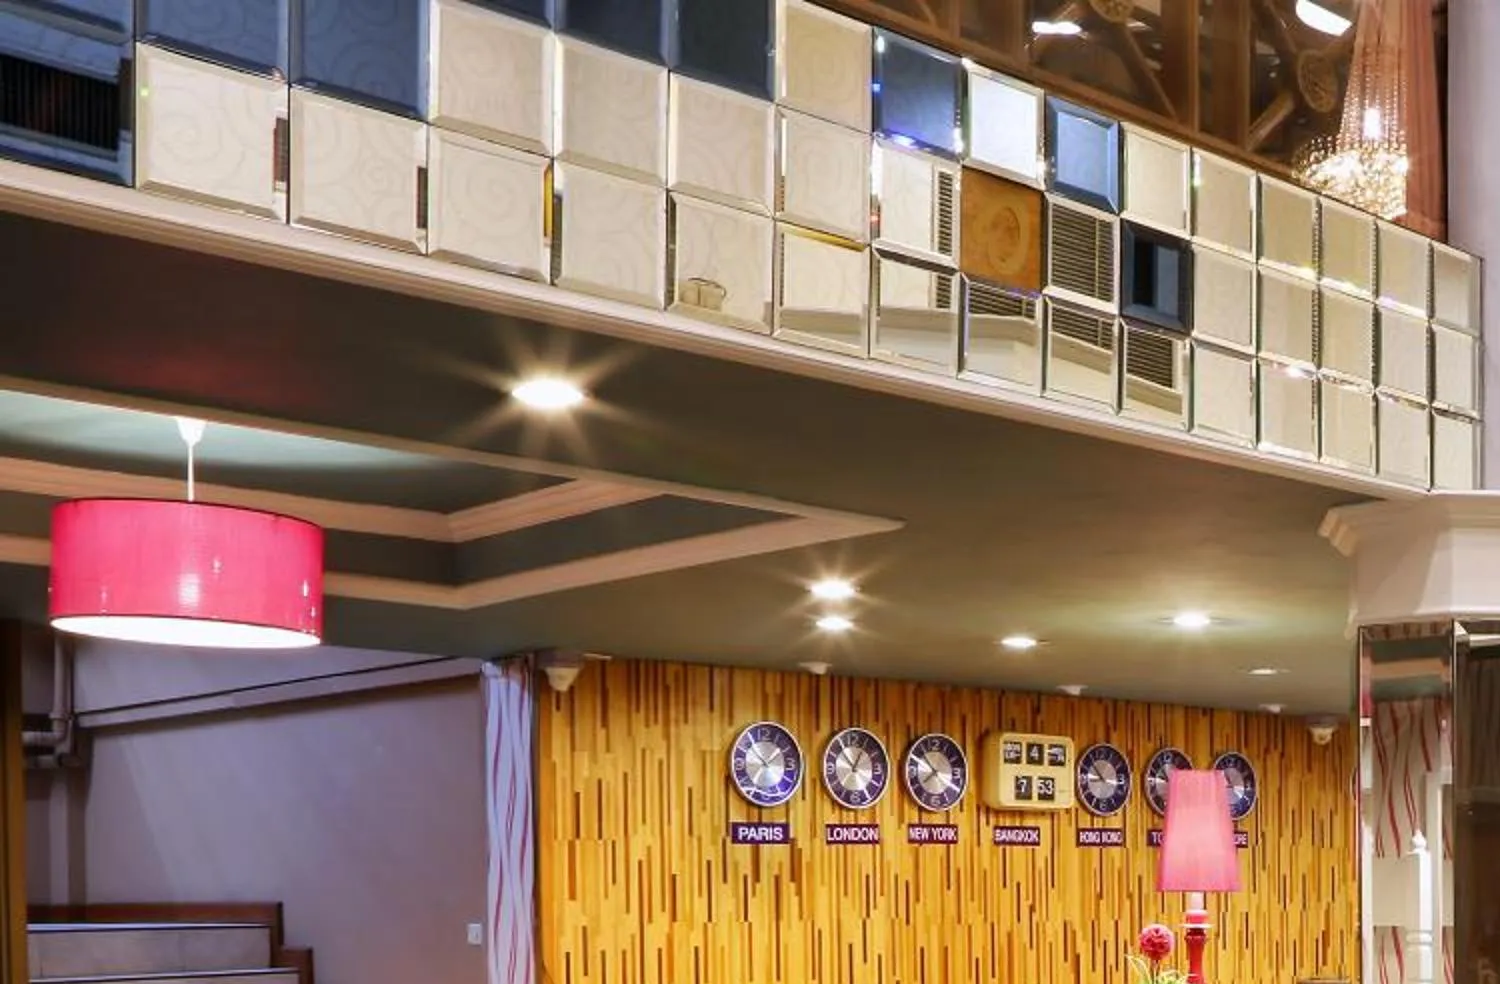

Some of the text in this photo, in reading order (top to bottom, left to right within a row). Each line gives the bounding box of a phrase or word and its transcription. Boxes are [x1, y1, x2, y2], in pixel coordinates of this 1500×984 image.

[1029, 745, 1039, 760] 4
[1018, 779, 1053, 794] 7 53
[738, 827, 783, 841] PARIS
[827, 827, 879, 841] LONDON
[909, 827, 957, 841] NEW YORK
[994, 829, 1039, 842] BANGKOK
[1079, 831, 1101, 843] HONG
